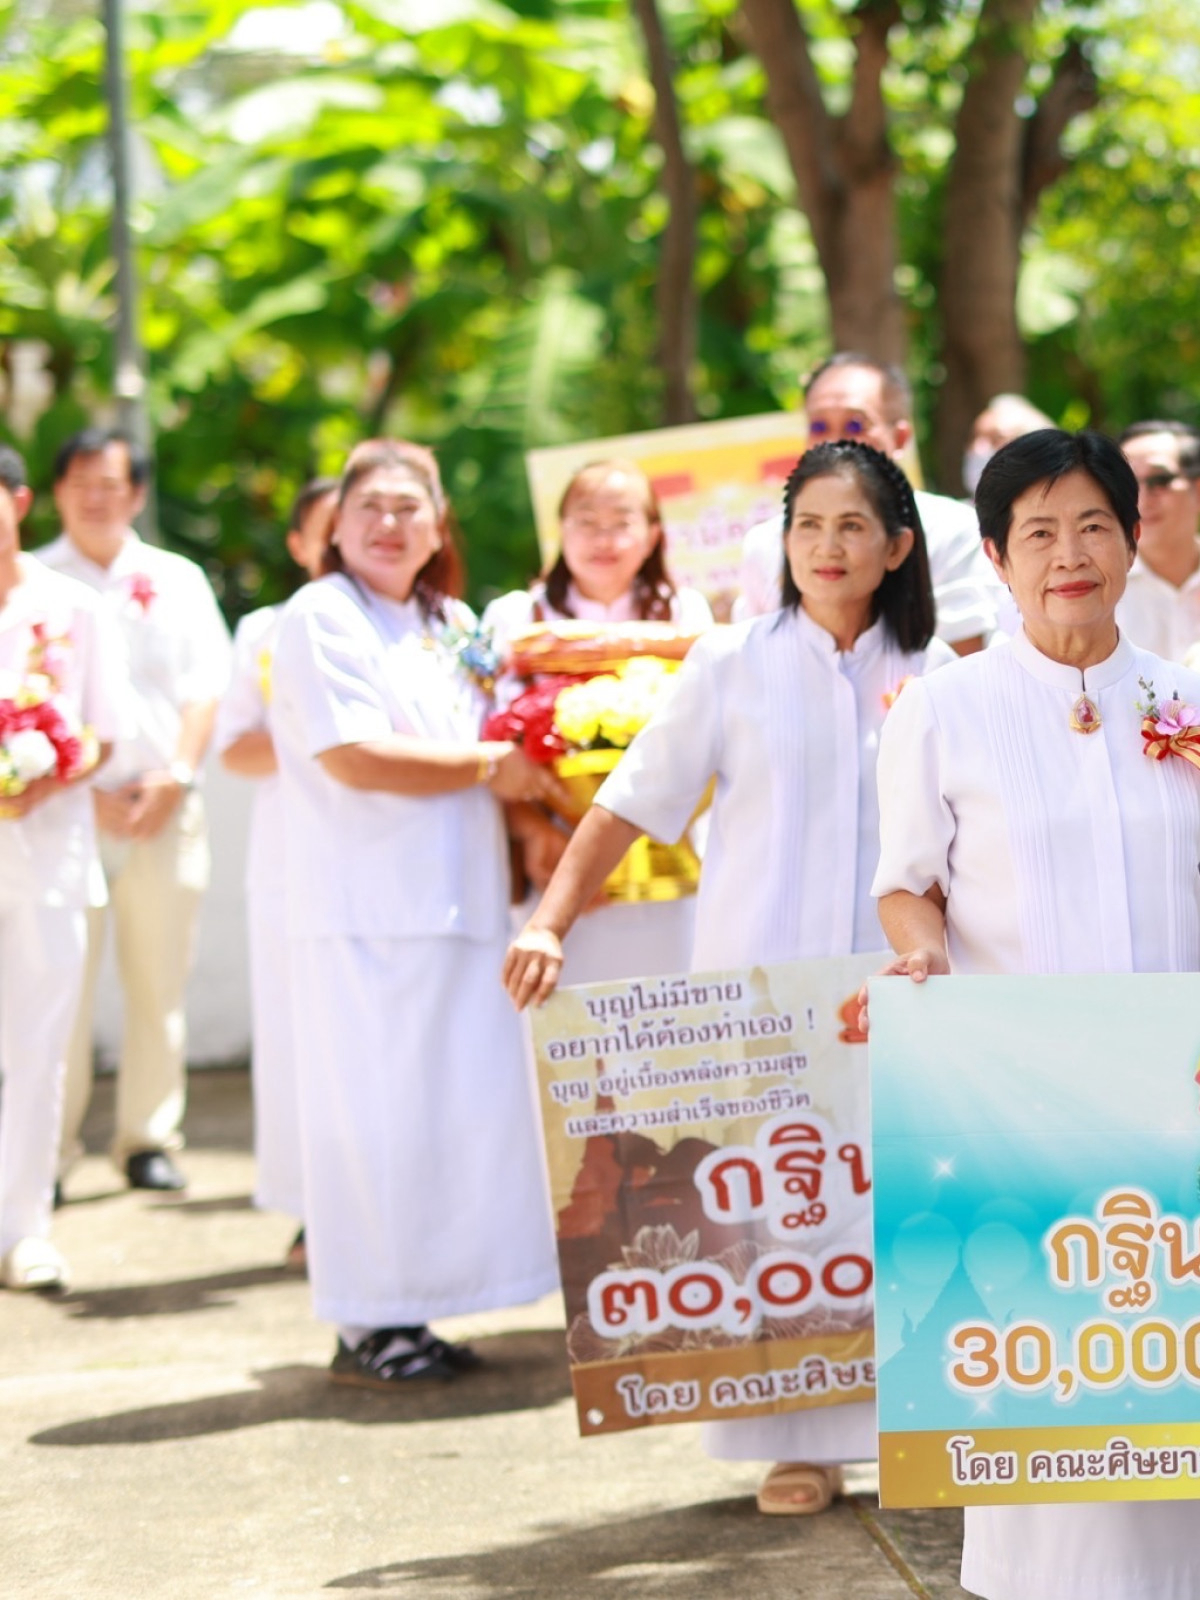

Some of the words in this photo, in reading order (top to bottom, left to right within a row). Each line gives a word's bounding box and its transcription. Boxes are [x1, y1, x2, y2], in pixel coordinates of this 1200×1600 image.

[586, 980, 742, 1023] บุญไม่มีขาย
[549, 1011, 793, 1060] อยากได้ต้องทำเอง
[807, 1007, 815, 1030] !
[552, 1080, 589, 1102] บุญ
[599, 1054, 808, 1096] อยู่เบื้องหลังความสุข
[568, 1088, 810, 1135] และความสำเร็จของชีวิต
[620, 1377, 696, 1414] โดย
[951, 1439, 1014, 1481] โดย
